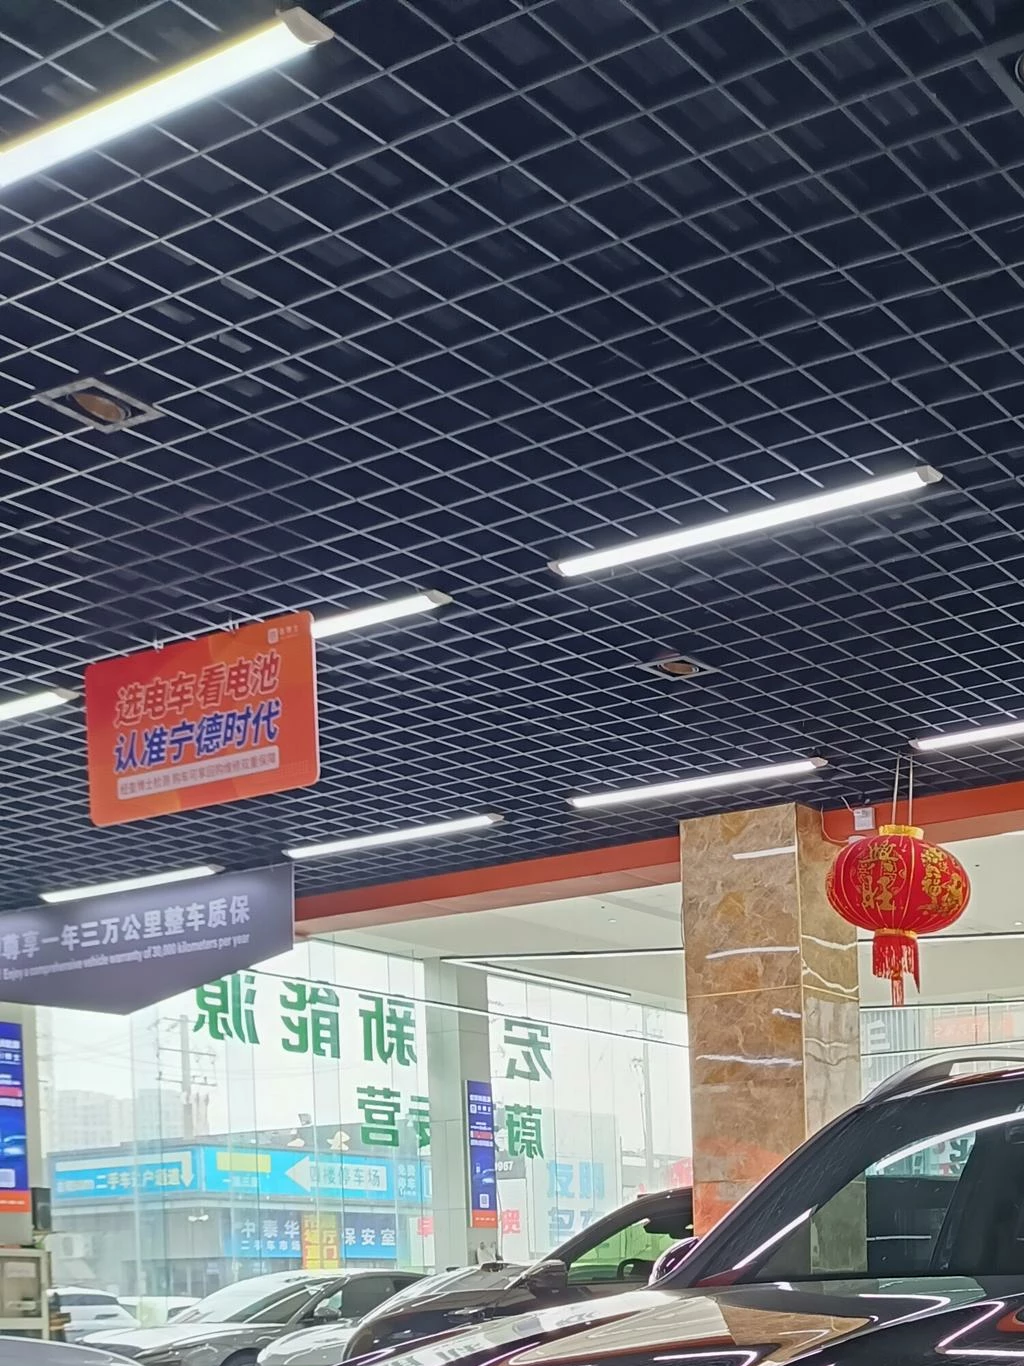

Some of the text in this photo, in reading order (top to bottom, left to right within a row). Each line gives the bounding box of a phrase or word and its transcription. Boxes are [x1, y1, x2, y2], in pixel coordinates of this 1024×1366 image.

[114, 650, 280, 727] 选电车看电池
[114, 699, 281, 772] 认准宁德时代
[0, 894, 250, 961] 尊享一年三万公里整车质保
